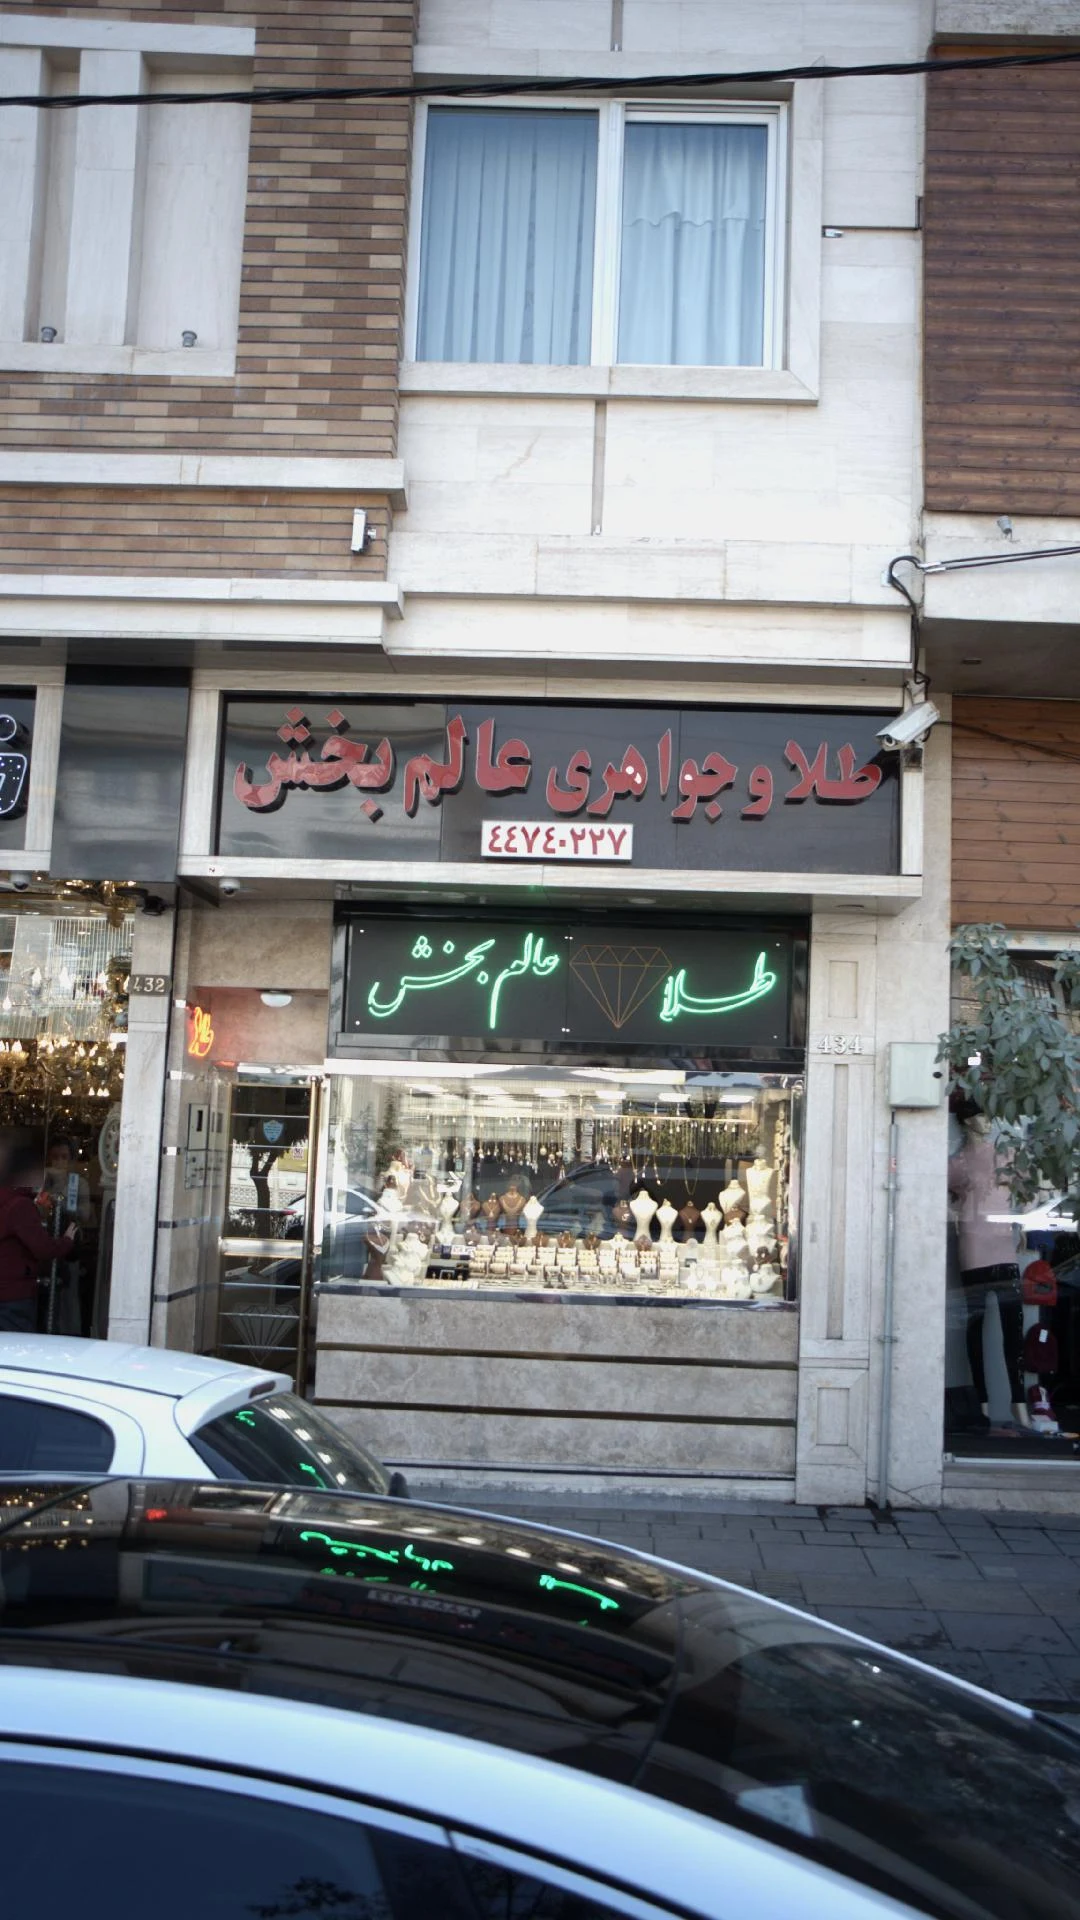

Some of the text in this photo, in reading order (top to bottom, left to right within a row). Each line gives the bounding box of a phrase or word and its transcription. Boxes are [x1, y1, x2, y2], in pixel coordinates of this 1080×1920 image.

[233, 706, 882, 820] طلا و جواهری عالم بخش
[132, 976, 165, 993] 432
[367, 932, 777, 1030] طلا عالم بخش
[816, 1034, 863, 1055] 434
